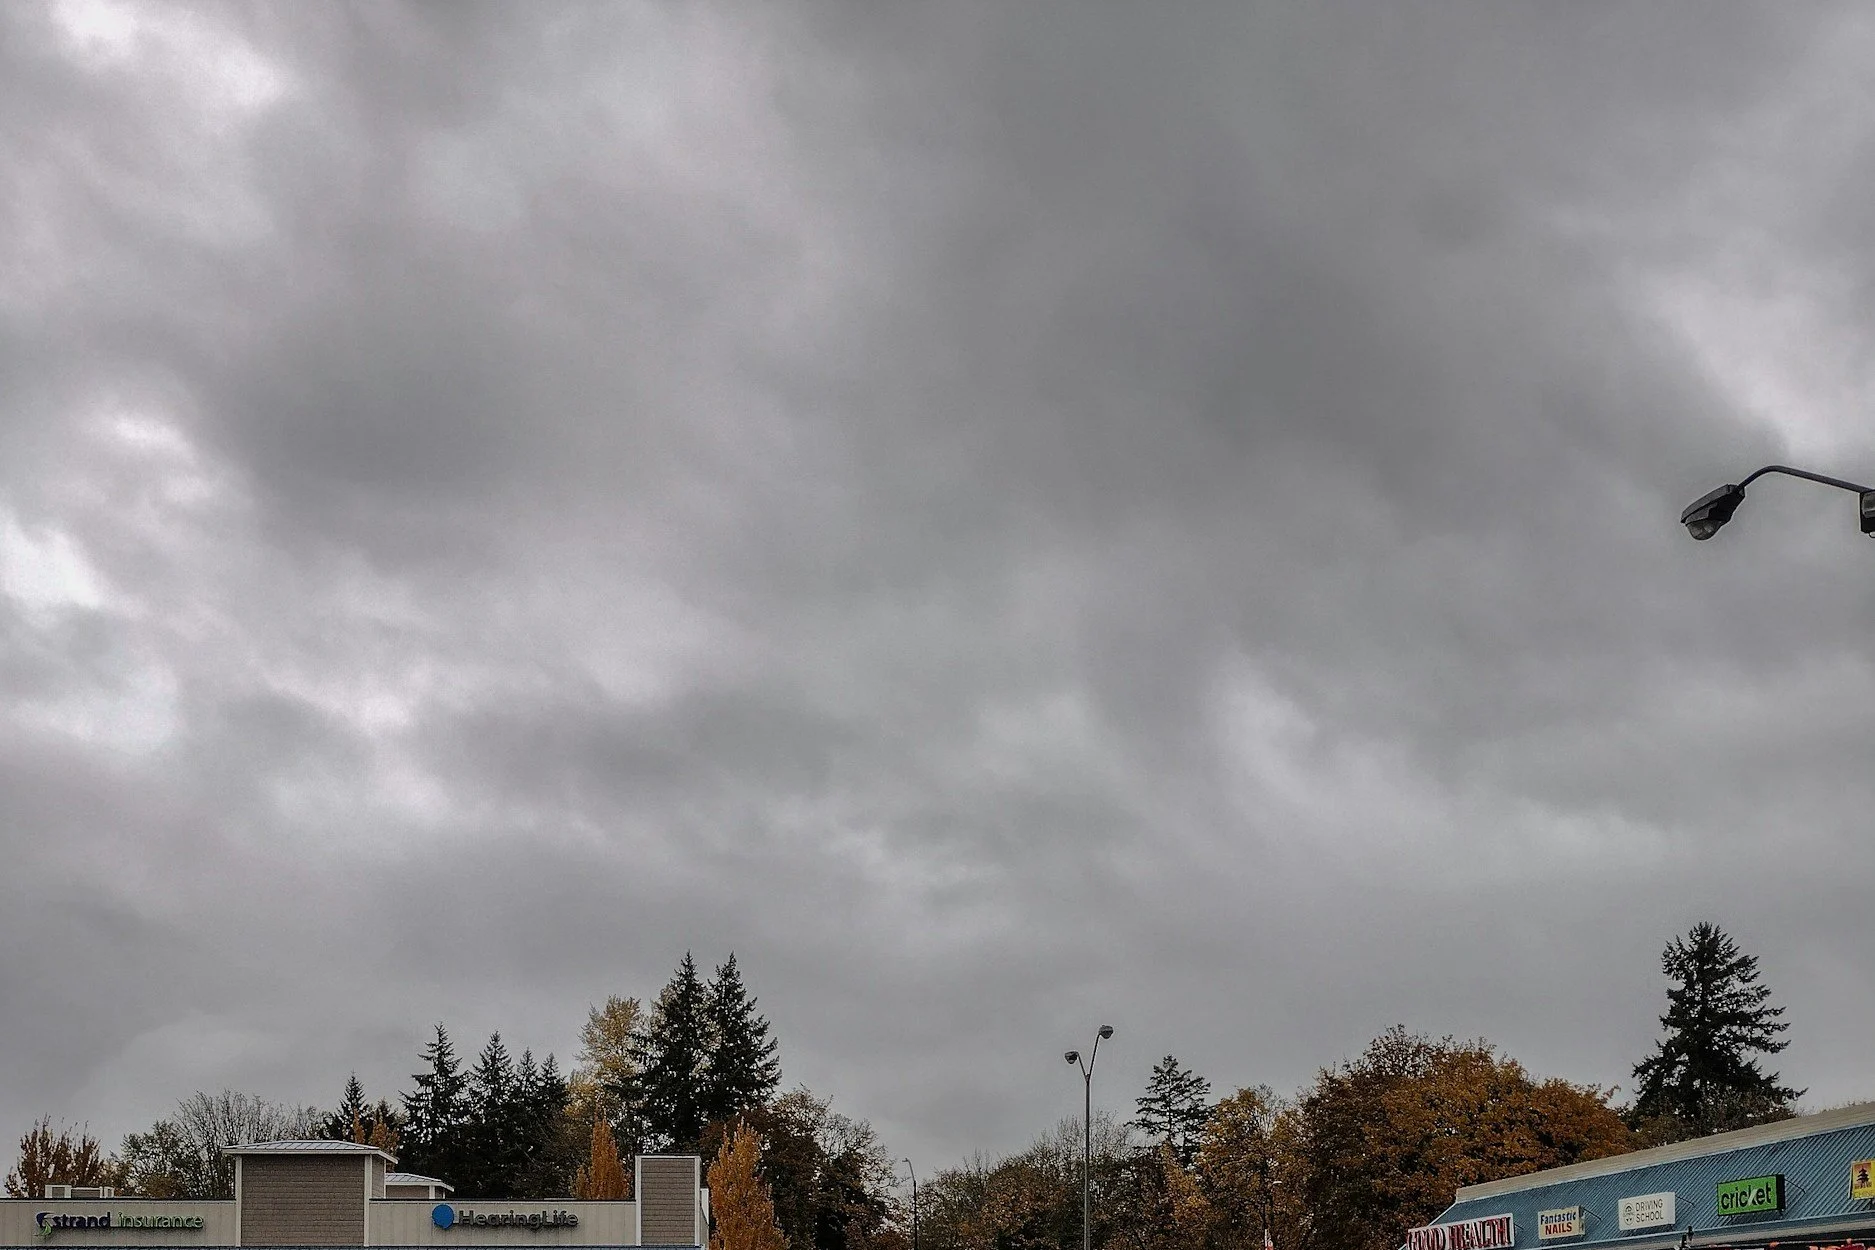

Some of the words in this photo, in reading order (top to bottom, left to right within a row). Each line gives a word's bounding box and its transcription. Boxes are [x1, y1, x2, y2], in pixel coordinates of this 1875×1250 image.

[1721, 1183, 1772, 1209] cricket
[1635, 1198, 1663, 1212] DRIVING
[52, 1212, 111, 1228] strand
[117, 1212, 204, 1228] insurance
[458, 1210, 579, 1230] HearingLife
[1540, 1209, 1577, 1225] Fantastic
[1635, 1210, 1664, 1223] SCHOOL
[1447, 1216, 1512, 1250] HEALTH
[1545, 1222, 1573, 1235] NAILS
